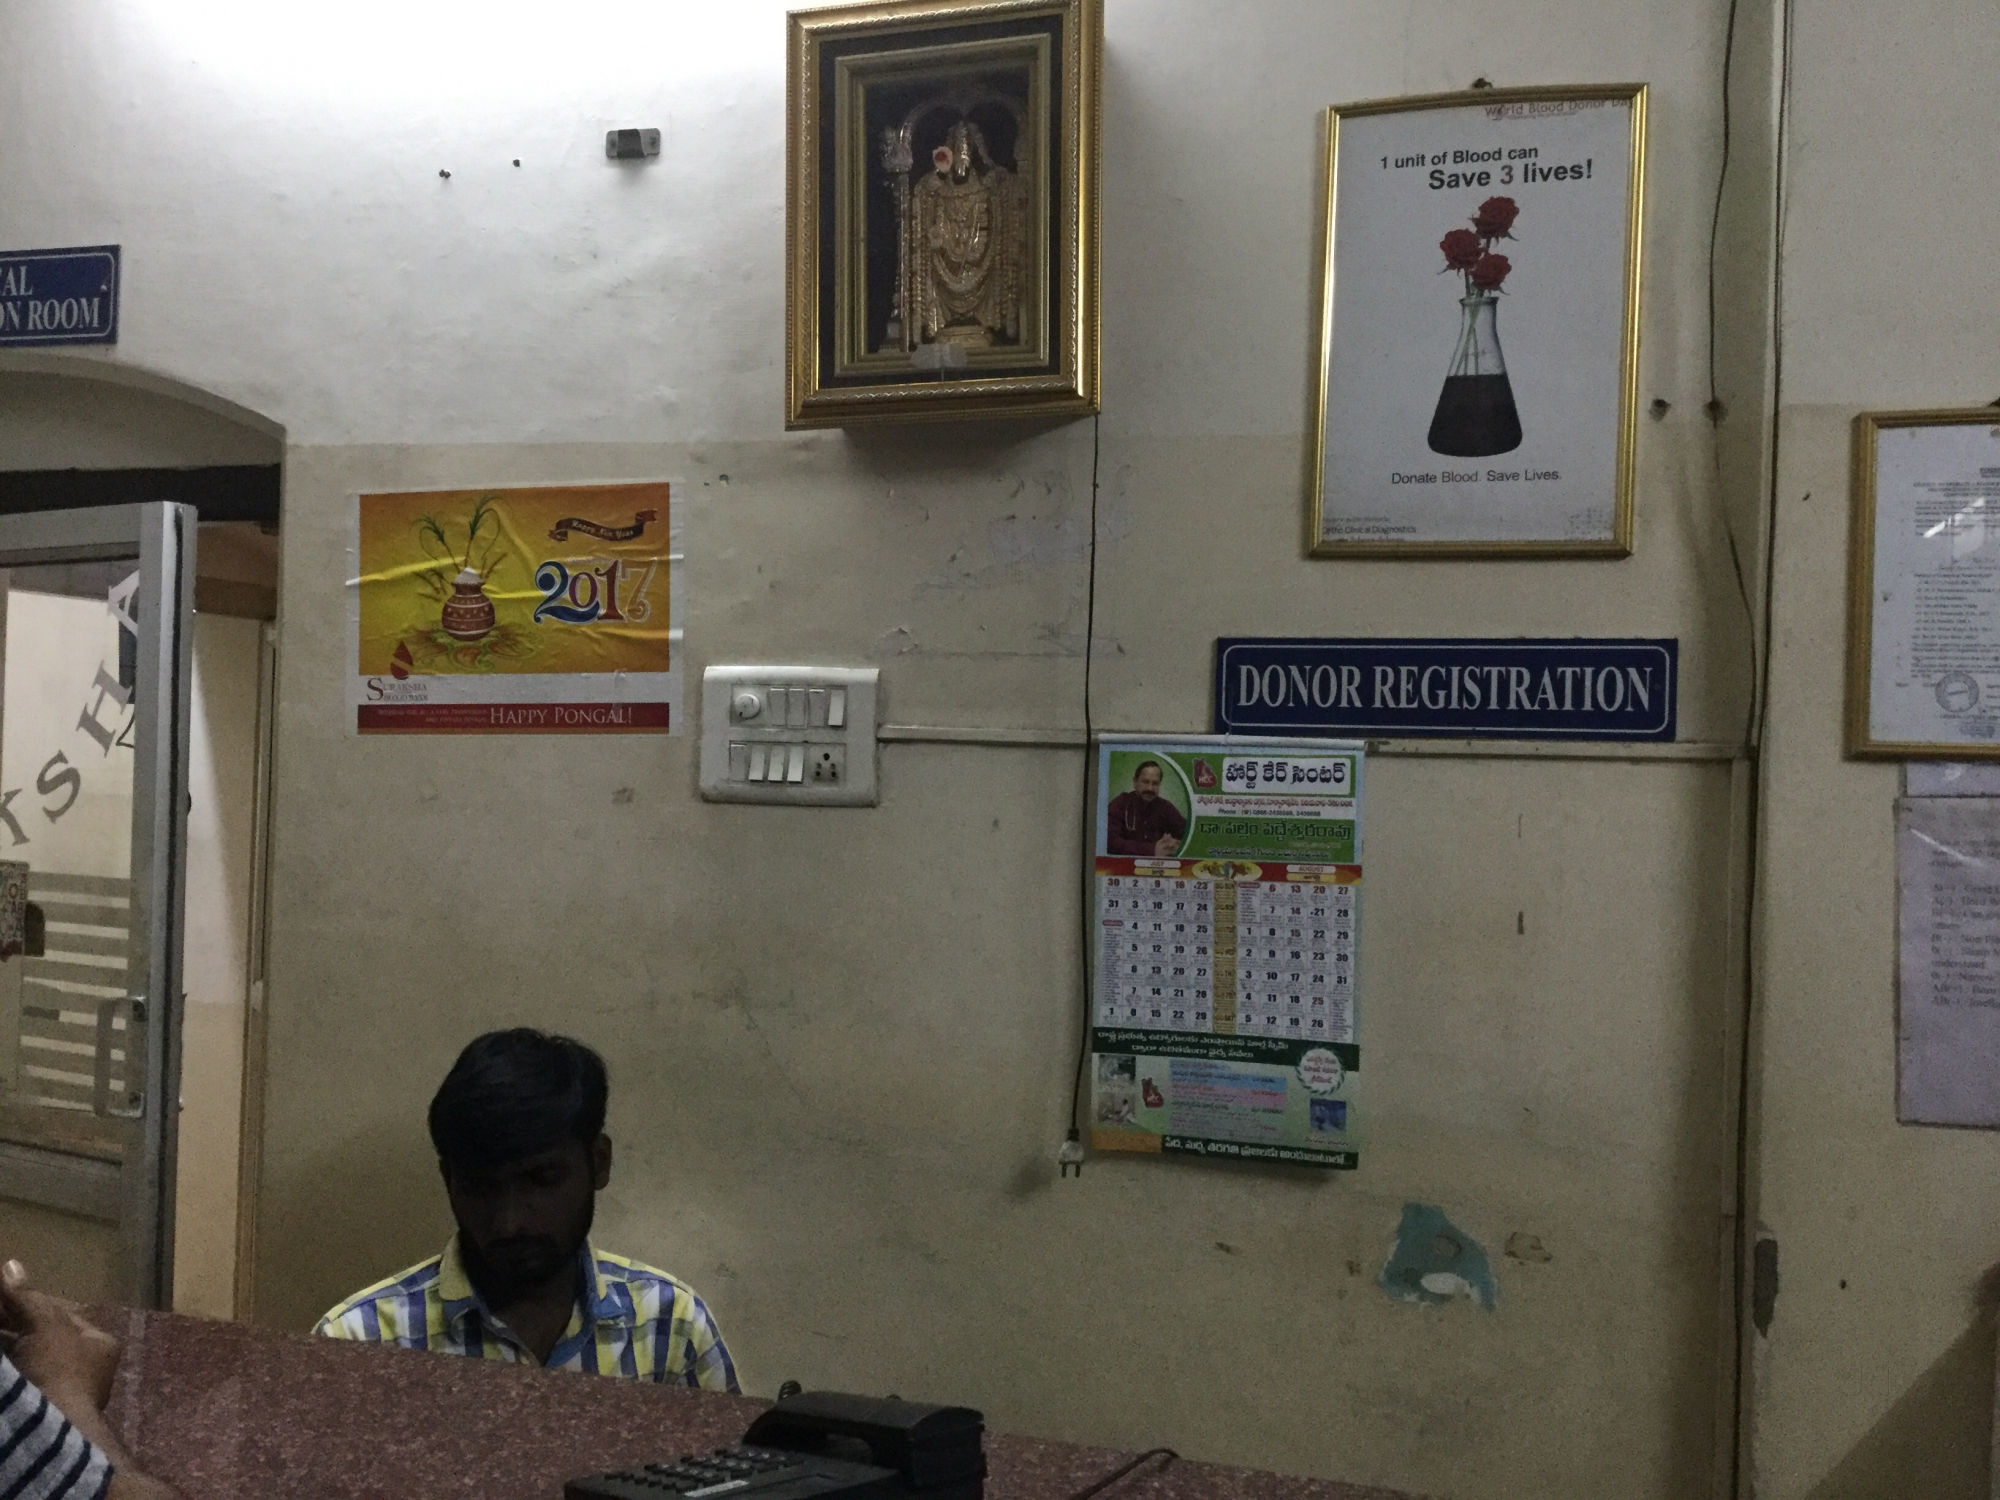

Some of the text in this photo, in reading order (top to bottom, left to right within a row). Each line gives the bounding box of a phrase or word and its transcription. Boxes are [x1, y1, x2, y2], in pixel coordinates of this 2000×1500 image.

[1528, 101, 1564, 114] Blood
[1381, 147, 1538, 169] 1 unit of Blood can
[1428, 159, 1593, 190] Save 3 lives!
[0, 265, 33, 296] AL
[27, 297, 101, 330] ROOM
[1391, 469, 1562, 485] Donate Blood. Save Lives.
[533, 559, 657, 624] 2017
[1237, 664, 1654, 712] DONOR REGISTRATION
[490, 707, 547, 724] HAPPY
[554, 706, 633, 724] PONGAL!
[1132, 879, 1138, 889] 2
[1337, 886, 1349, 895] 27
[1174, 902, 1186, 911] 17
[1196, 903, 1208, 912] 24
[1269, 905, 1276, 914] 7
[1289, 906, 1302, 916] 14
[1313, 907, 1326, 917] 21
[1131, 921, 1138, 931] 4
[1151, 922, 1164, 932] 11
[1246, 926, 1252, 936] 1
[1313, 929, 1325, 939] 22
[1150, 944, 1163, 953] 12
[1245, 948, 1252, 958] 2
[1195, 967, 1208, 977] 27
[1288, 972, 1301, 982] 17
[1312, 974, 1325, 984] 24
[1130, 986, 1137, 995] 7
[1150, 987, 1162, 997] 14
[1172, 988, 1185, 998] 21
[1244, 991, 1251, 1001] 4
[1265, 993, 1278, 1002] 11
[1108, 1007, 1114, 1016] 1
[1172, 1010, 1185, 1019] 22
[1265, 1015, 1277, 1025] 12
